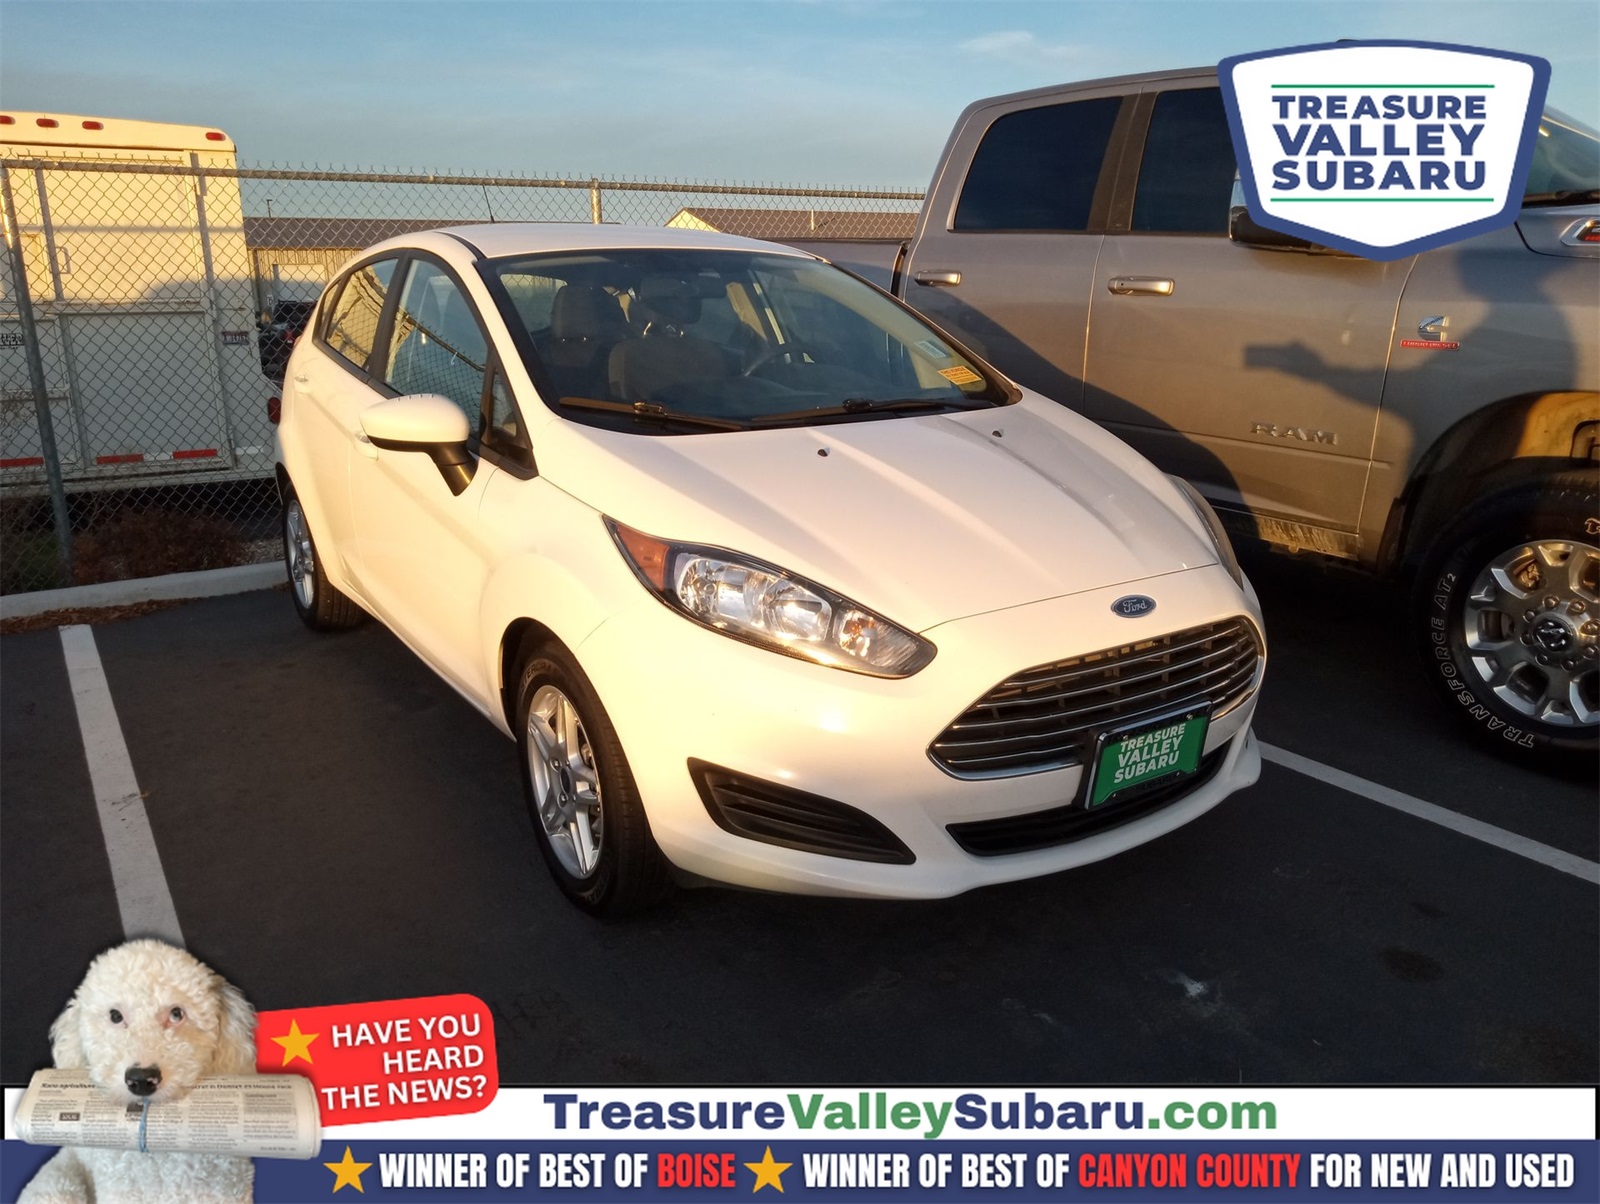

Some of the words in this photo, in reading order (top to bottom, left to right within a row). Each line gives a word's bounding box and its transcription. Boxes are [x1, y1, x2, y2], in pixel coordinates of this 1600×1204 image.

[1251, 421, 1338, 446] RAM
[1123, 599, 1147, 612] Ford
[1431, 617, 1534, 748] TRANSFORCE
[1118, 735, 1183, 767] VALLEY
[1120, 723, 1186, 752] TREASURE
[1114, 751, 1179, 783] SUBARU
